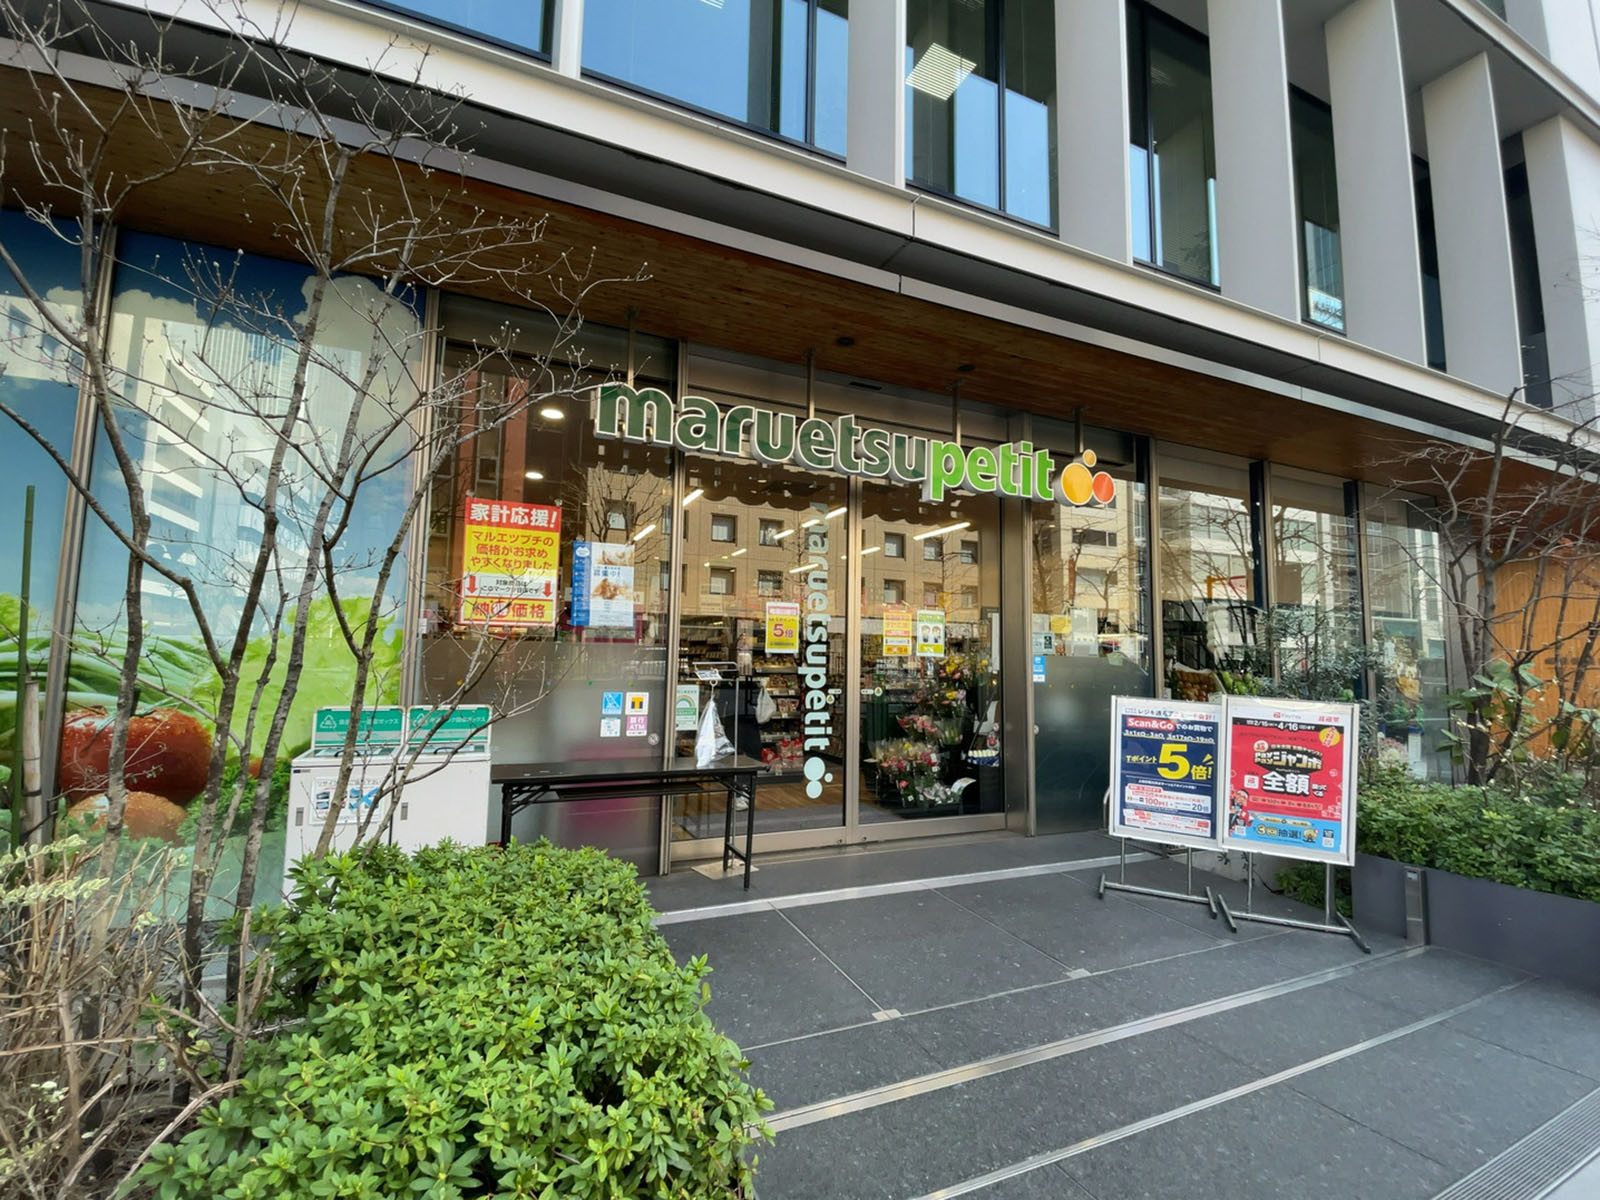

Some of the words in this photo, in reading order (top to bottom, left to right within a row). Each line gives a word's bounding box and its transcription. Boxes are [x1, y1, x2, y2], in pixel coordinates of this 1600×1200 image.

[470, 503, 558, 528] 家計応援!
[476, 544, 548, 558] 価格がお求め
[471, 556, 552, 570] やすくなりました
[1127, 718, 1174, 730] Scan&Go
[1262, 771, 1310, 796] 全額
